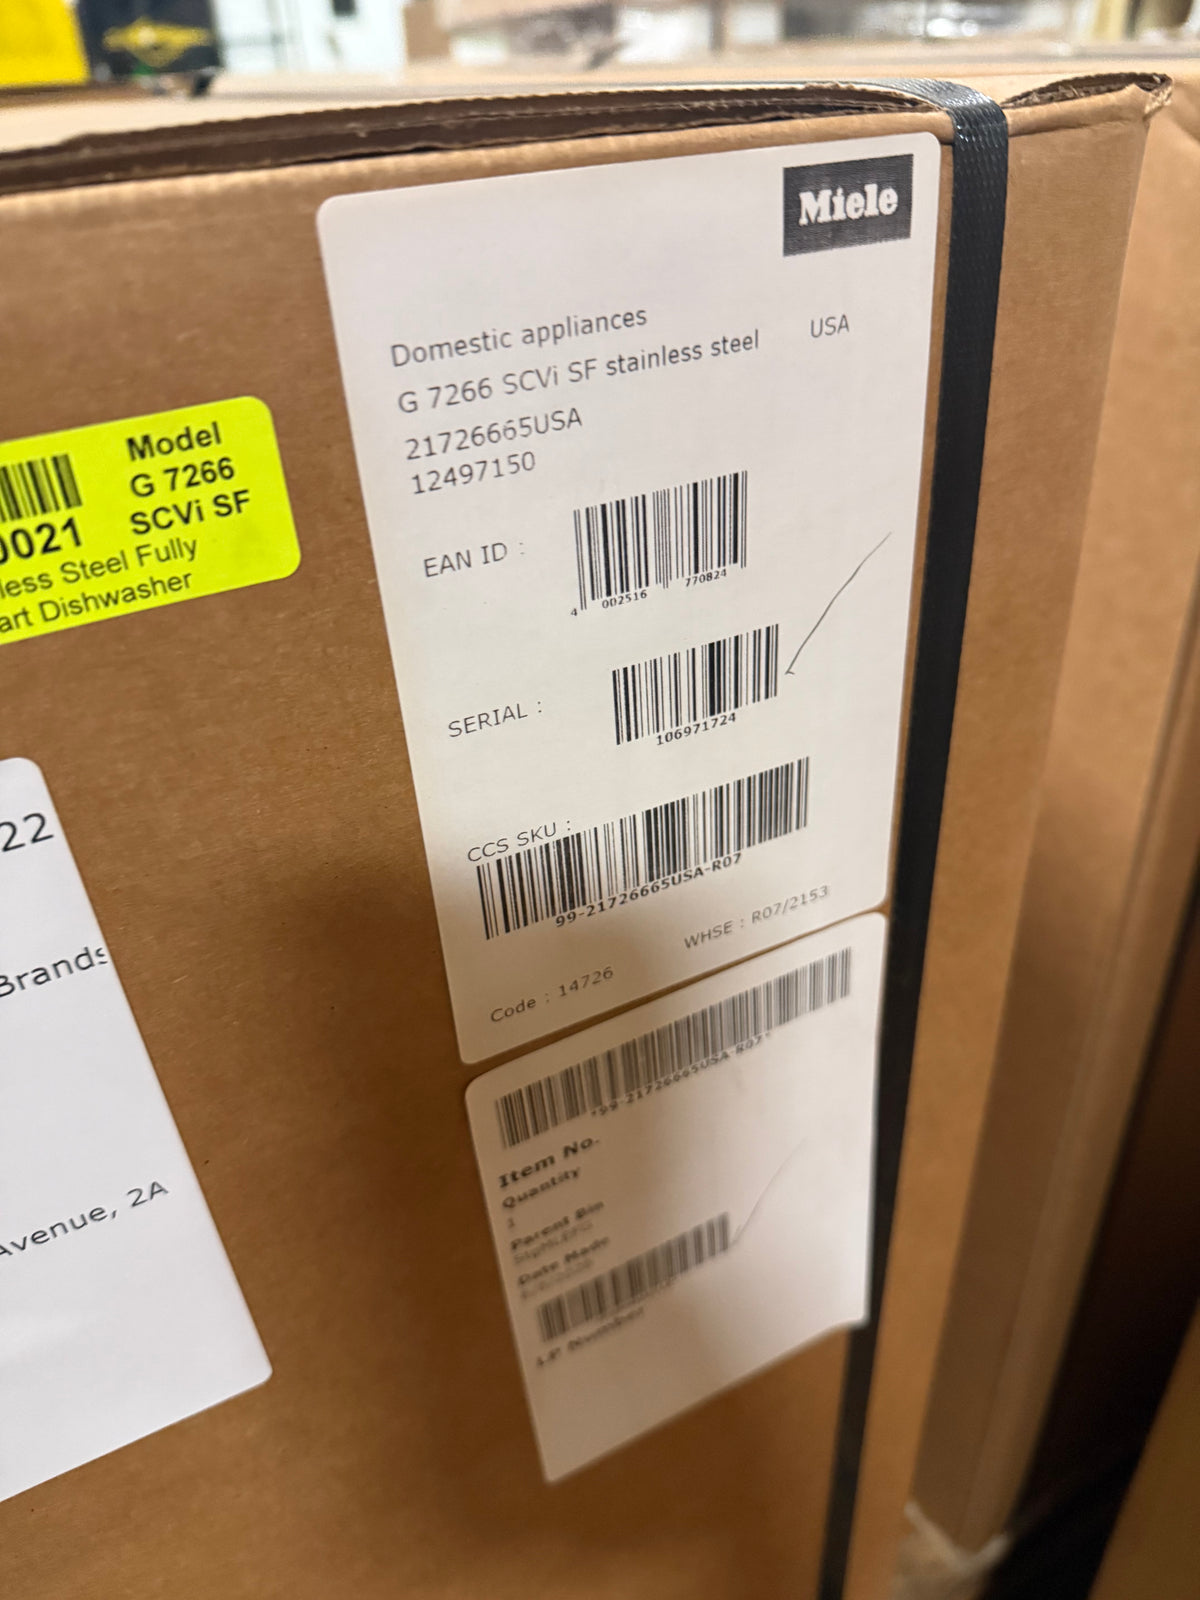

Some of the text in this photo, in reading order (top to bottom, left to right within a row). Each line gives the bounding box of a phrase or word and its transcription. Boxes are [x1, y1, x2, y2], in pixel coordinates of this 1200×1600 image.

[799, 183, 899, 226] Miele
[390, 307, 648, 368] Domestic appliances
[810, 314, 850, 338] USA
[398, 328, 760, 414] G 7266 SCVi SF stainless steel
[127, 421, 222, 461] Model
[405, 407, 583, 461] 21726665USA
[130, 457, 235, 497] G 7266
[411, 450, 536, 495] 12497150
[130, 489, 250, 535] SCVi SF
[60, 549, 129, 584] Steel
[136, 537, 197, 568] Fully
[424, 549, 472, 578] EAN
[482, 542, 508, 565] ID
[39, 572, 192, 622] Dishwasher
[570, 568, 728, 617] 4 002516 770824
[447, 703, 528, 738] SERIAL
[656, 713, 737, 746] 106971724
[467, 838, 509, 863] CCS
[517, 822, 557, 848] SKU
[555, 852, 742, 928] 99-21726665USA-R07
[683, 920, 734, 949] WHSE
[490, 994, 536, 1023] Code
[558, 965, 614, 997] 14726
[498, 1136, 600, 1188] Item No.
[126, 1181, 169, 1208] 2A
[502, 1166, 582, 1209] Quantity
